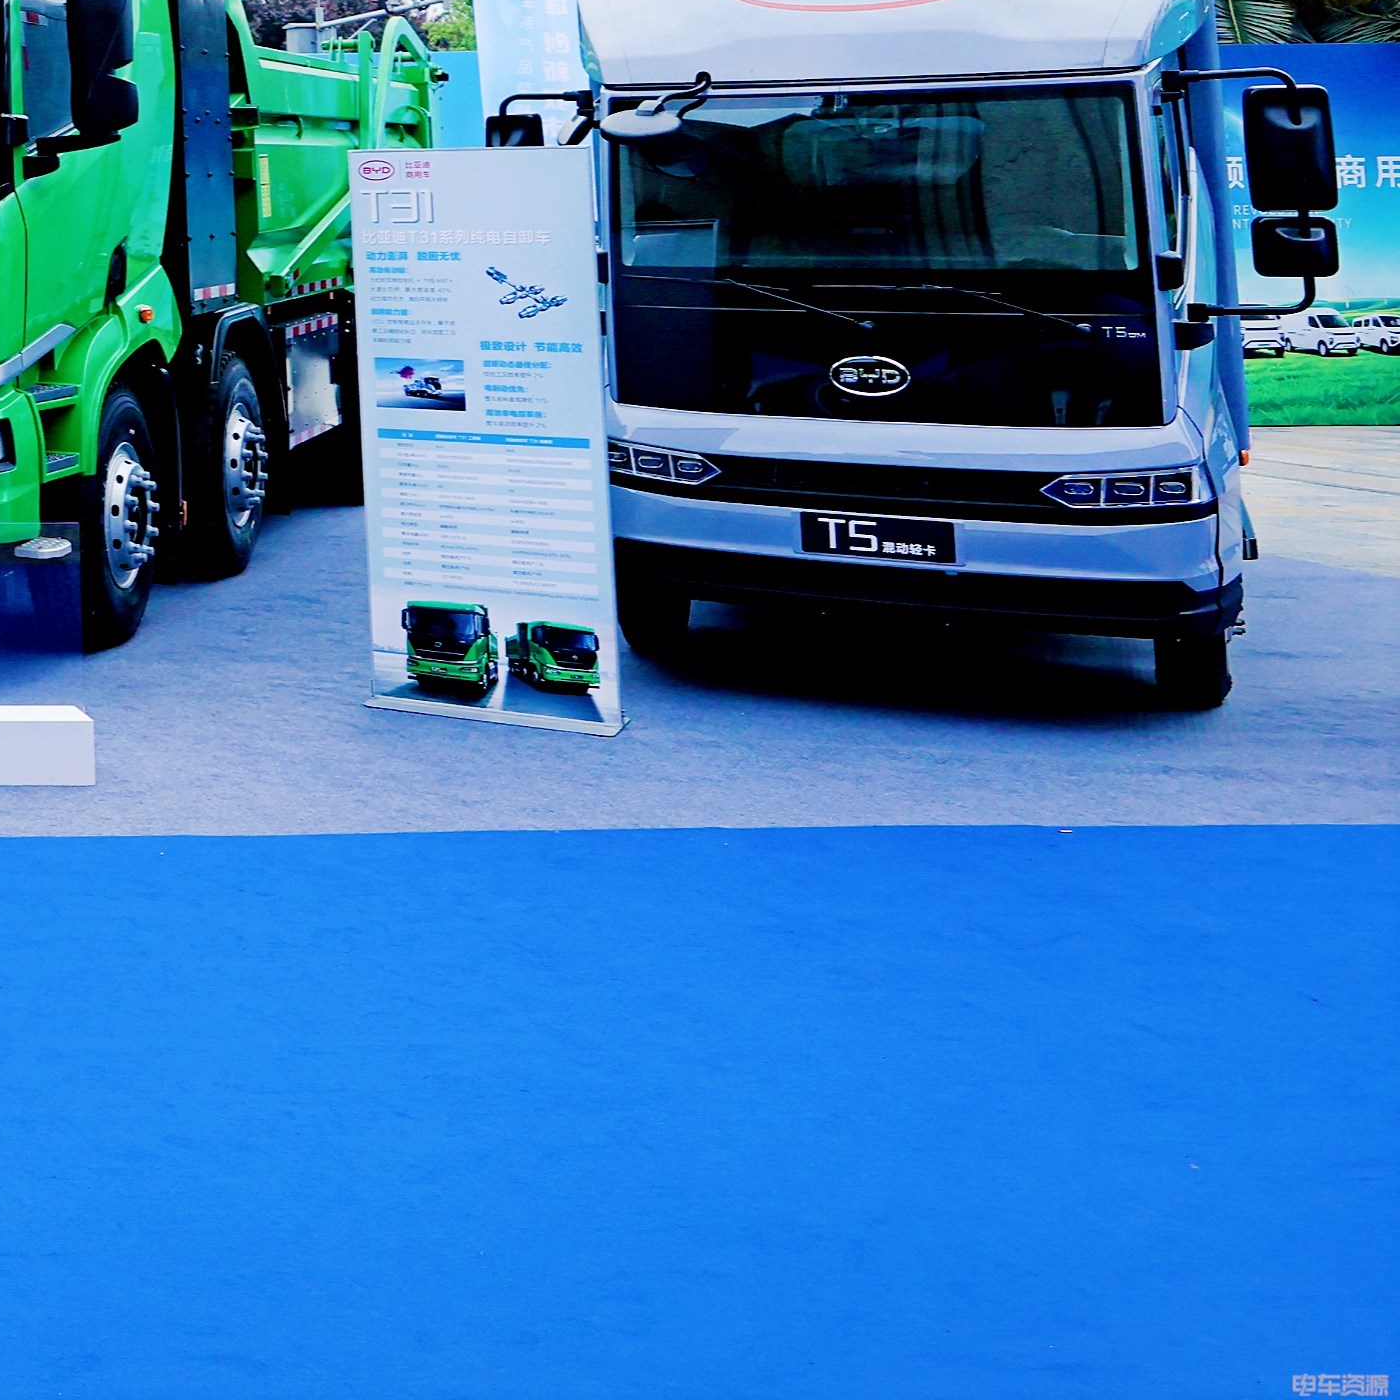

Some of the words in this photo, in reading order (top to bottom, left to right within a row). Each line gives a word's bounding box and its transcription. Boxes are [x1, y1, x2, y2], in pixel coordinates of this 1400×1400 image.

[405, 161, 431, 169] 比亚迪
[405, 171, 431, 179] 商用车
[360, 189, 435, 224] T31
[362, 230, 552, 246] 比亚迪T31系列纯电自卸车
[534, 342, 583, 353] 节能高效
[817, 517, 879, 552] T5
[881, 541, 937, 557] 混动轻卡
